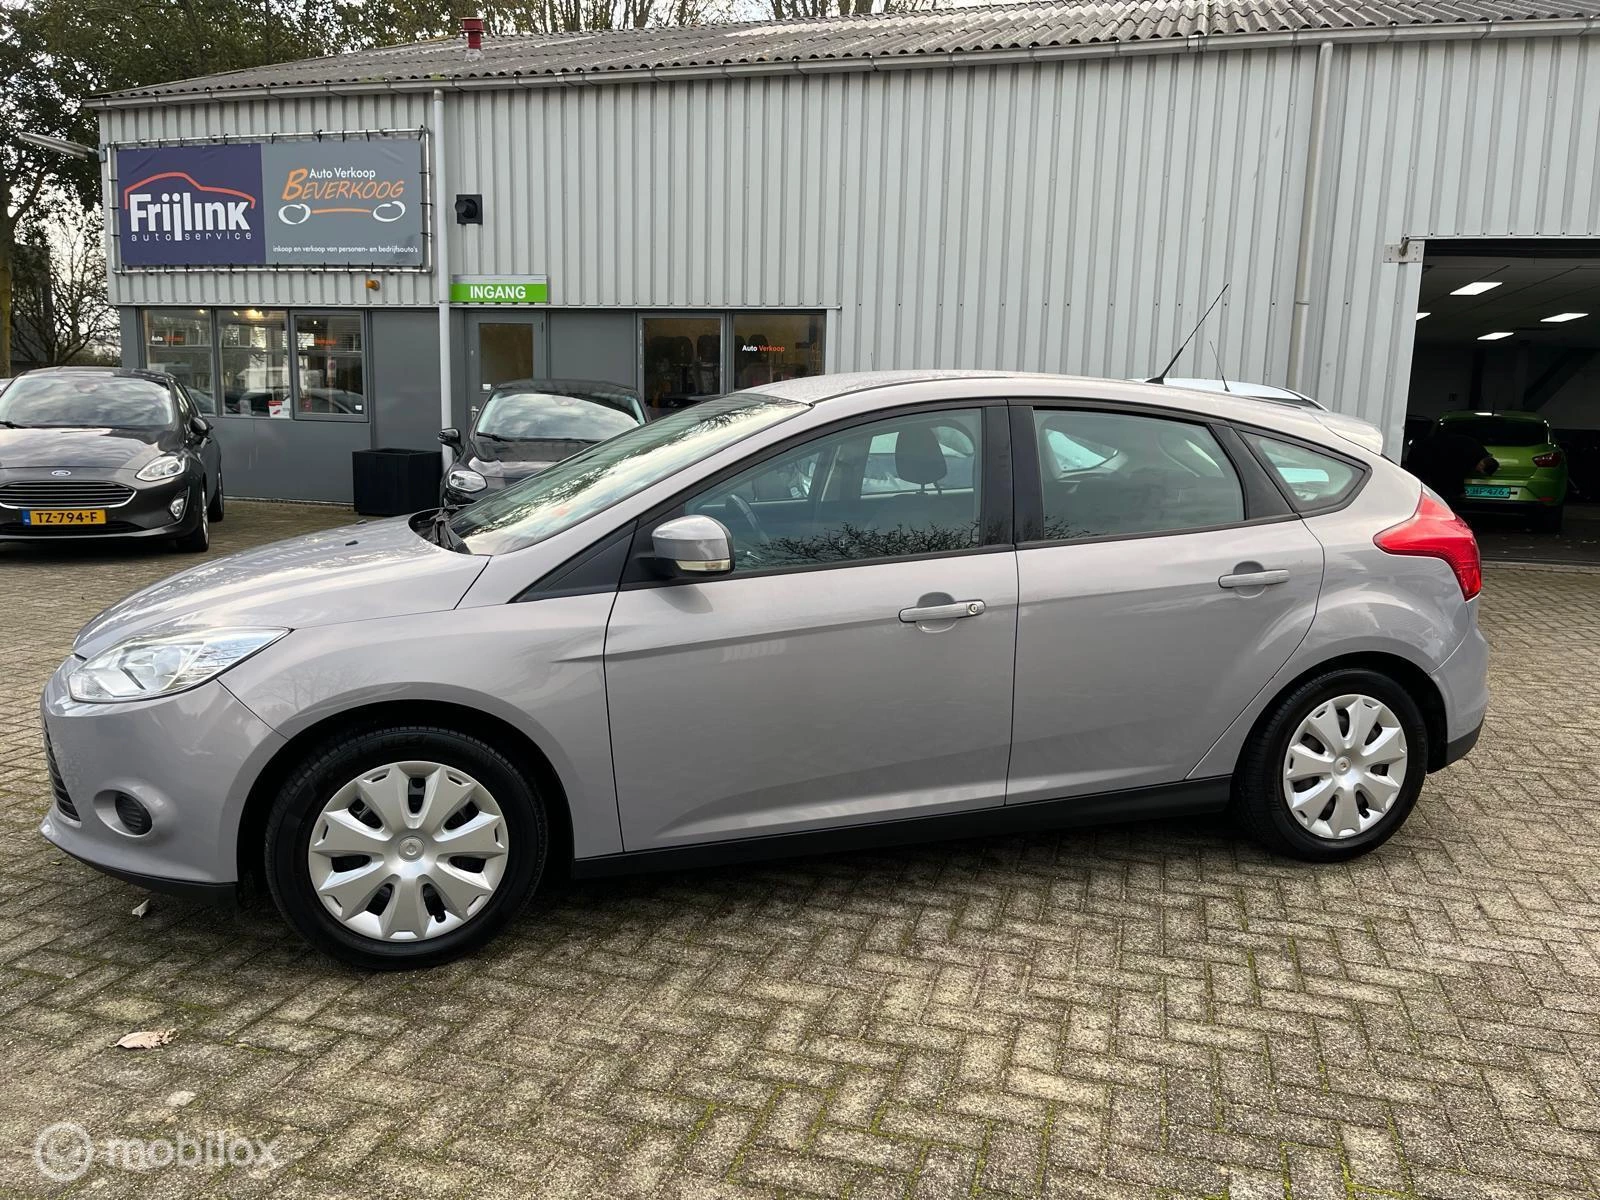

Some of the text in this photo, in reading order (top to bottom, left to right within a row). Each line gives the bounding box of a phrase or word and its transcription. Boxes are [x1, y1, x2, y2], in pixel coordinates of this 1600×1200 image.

[309, 167, 376, 180] Auto Verkoop
[281, 168, 405, 201] BEVERKOOG
[129, 192, 251, 241] Frijlink
[131, 231, 253, 242] auto service
[272, 244, 292, 253] inkoop
[302, 244, 326, 253] verkoop
[470, 285, 526, 299] INGANG
[758, 345, 785, 353] Verkoop
[36, 512, 97, 523] TZ-794-F
